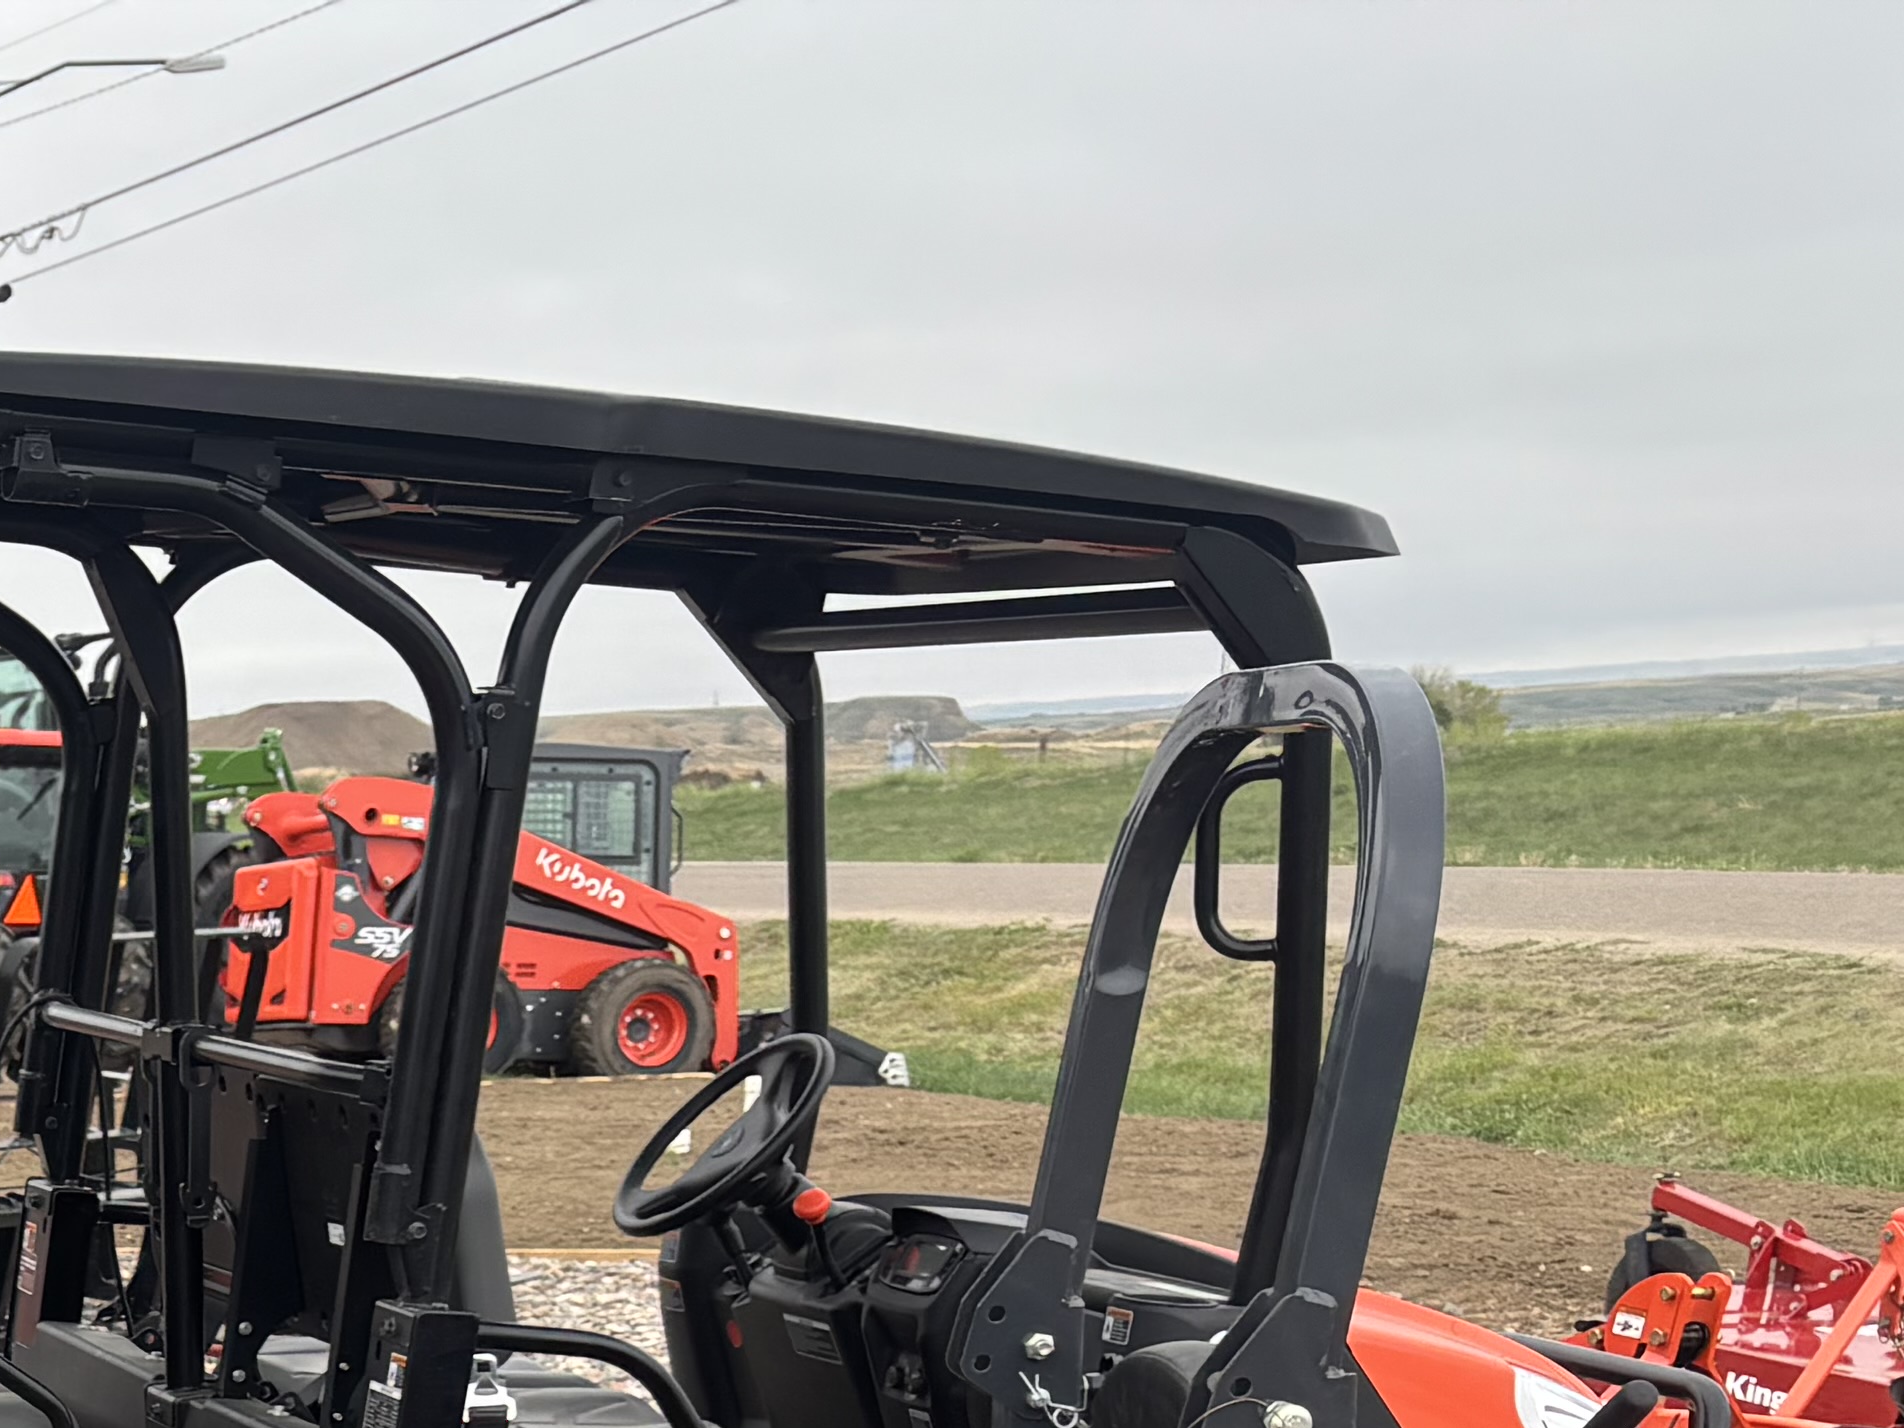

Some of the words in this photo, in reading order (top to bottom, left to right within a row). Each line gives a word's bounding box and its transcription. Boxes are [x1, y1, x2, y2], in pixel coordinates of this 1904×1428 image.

[535, 846, 626, 910] Kubota
[353, 926, 414, 945] SSV
[369, 943, 401, 960] 75
